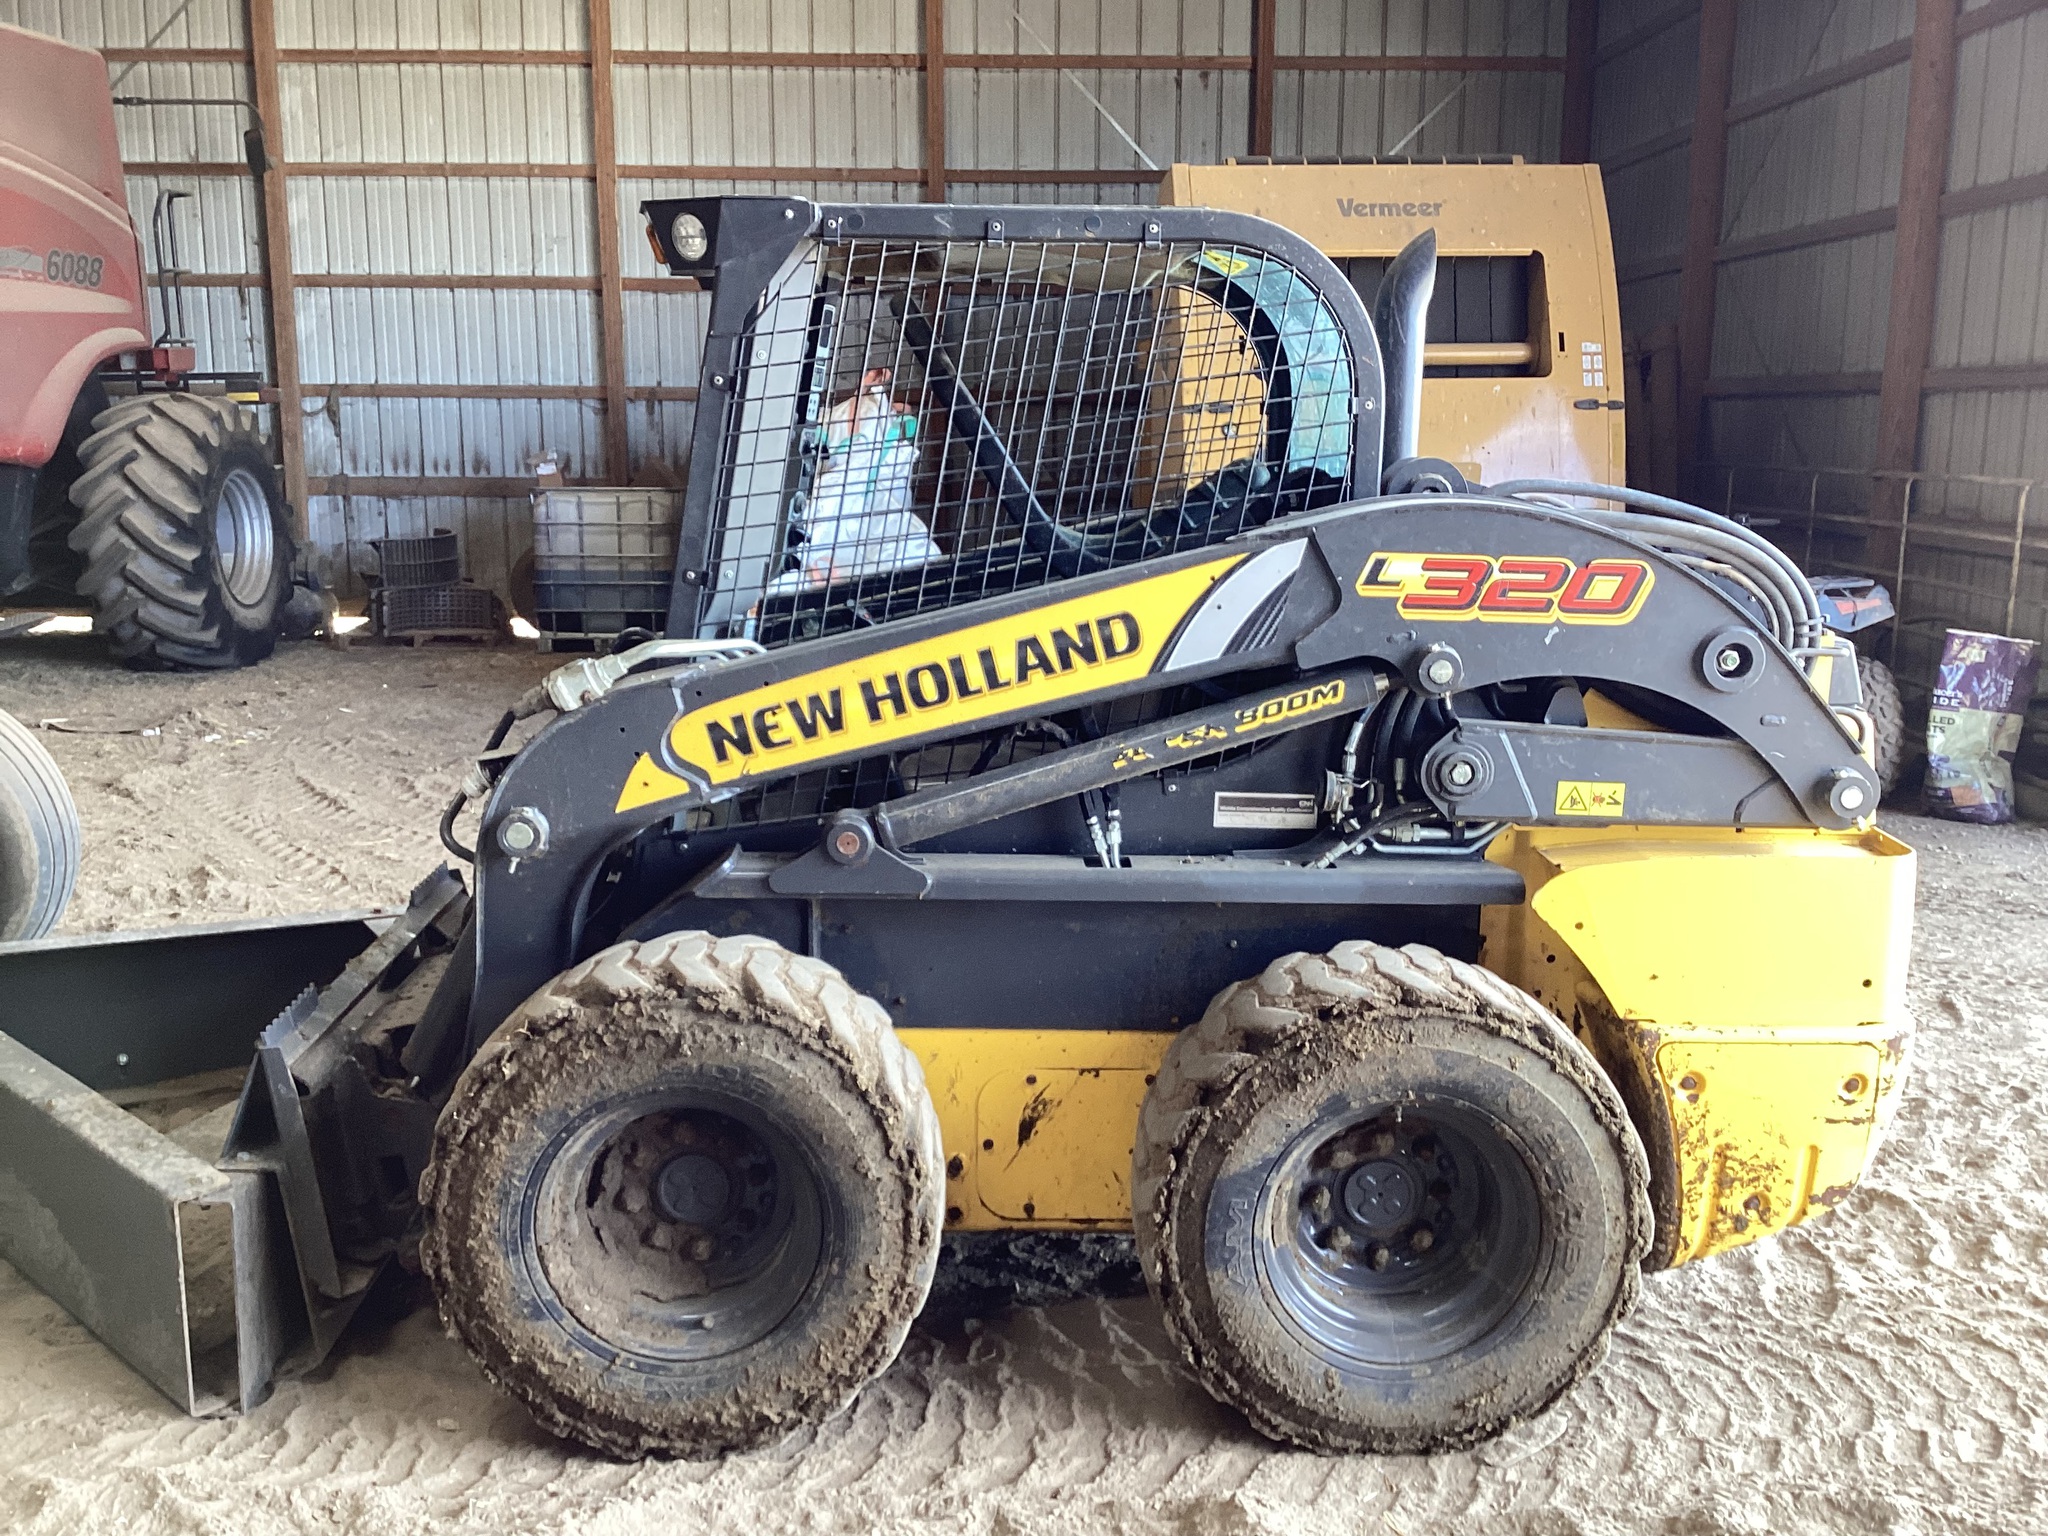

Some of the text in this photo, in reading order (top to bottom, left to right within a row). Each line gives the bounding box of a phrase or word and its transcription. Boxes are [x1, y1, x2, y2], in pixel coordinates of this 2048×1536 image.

[1336, 198, 1443, 217] Vermeer
[46, 249, 104, 288] 6088
[1359, 555, 1652, 619] L320
[705, 610, 1142, 763] NEW HOLLAND
